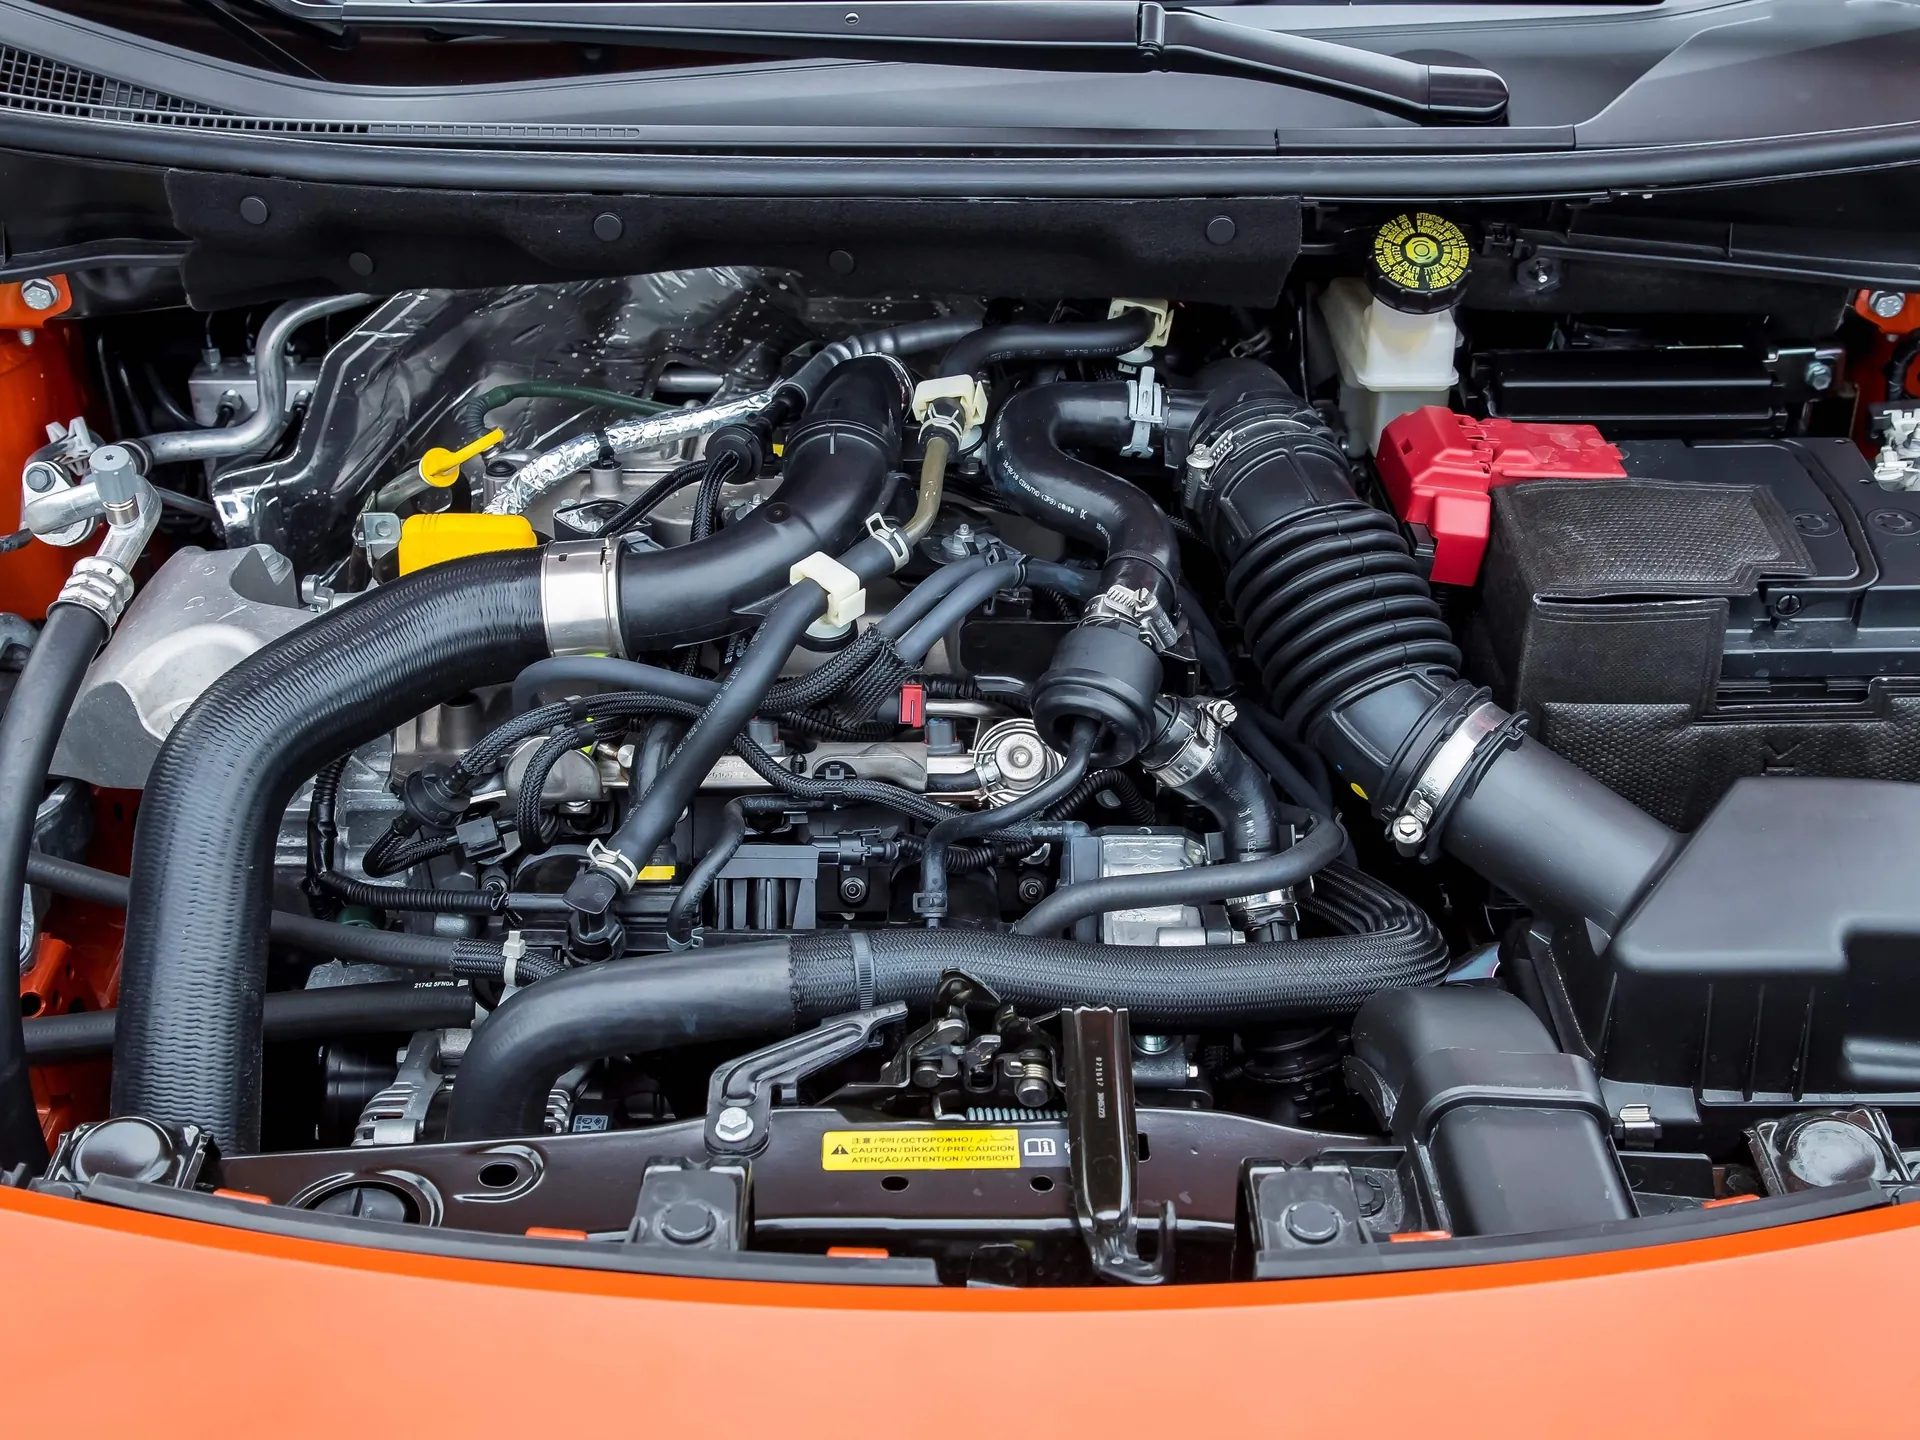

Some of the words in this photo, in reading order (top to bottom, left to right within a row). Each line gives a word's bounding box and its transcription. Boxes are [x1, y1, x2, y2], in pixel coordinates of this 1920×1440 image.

[1416, 212, 1444, 224] ATTENTION
[1392, 245, 1403, 262] CLEAN
[1400, 261, 1420, 274] FILLER
[1392, 264, 1403, 274] USE
[1376, 255, 1392, 273] SEALED
[1388, 271, 1419, 288] CONTAINER
